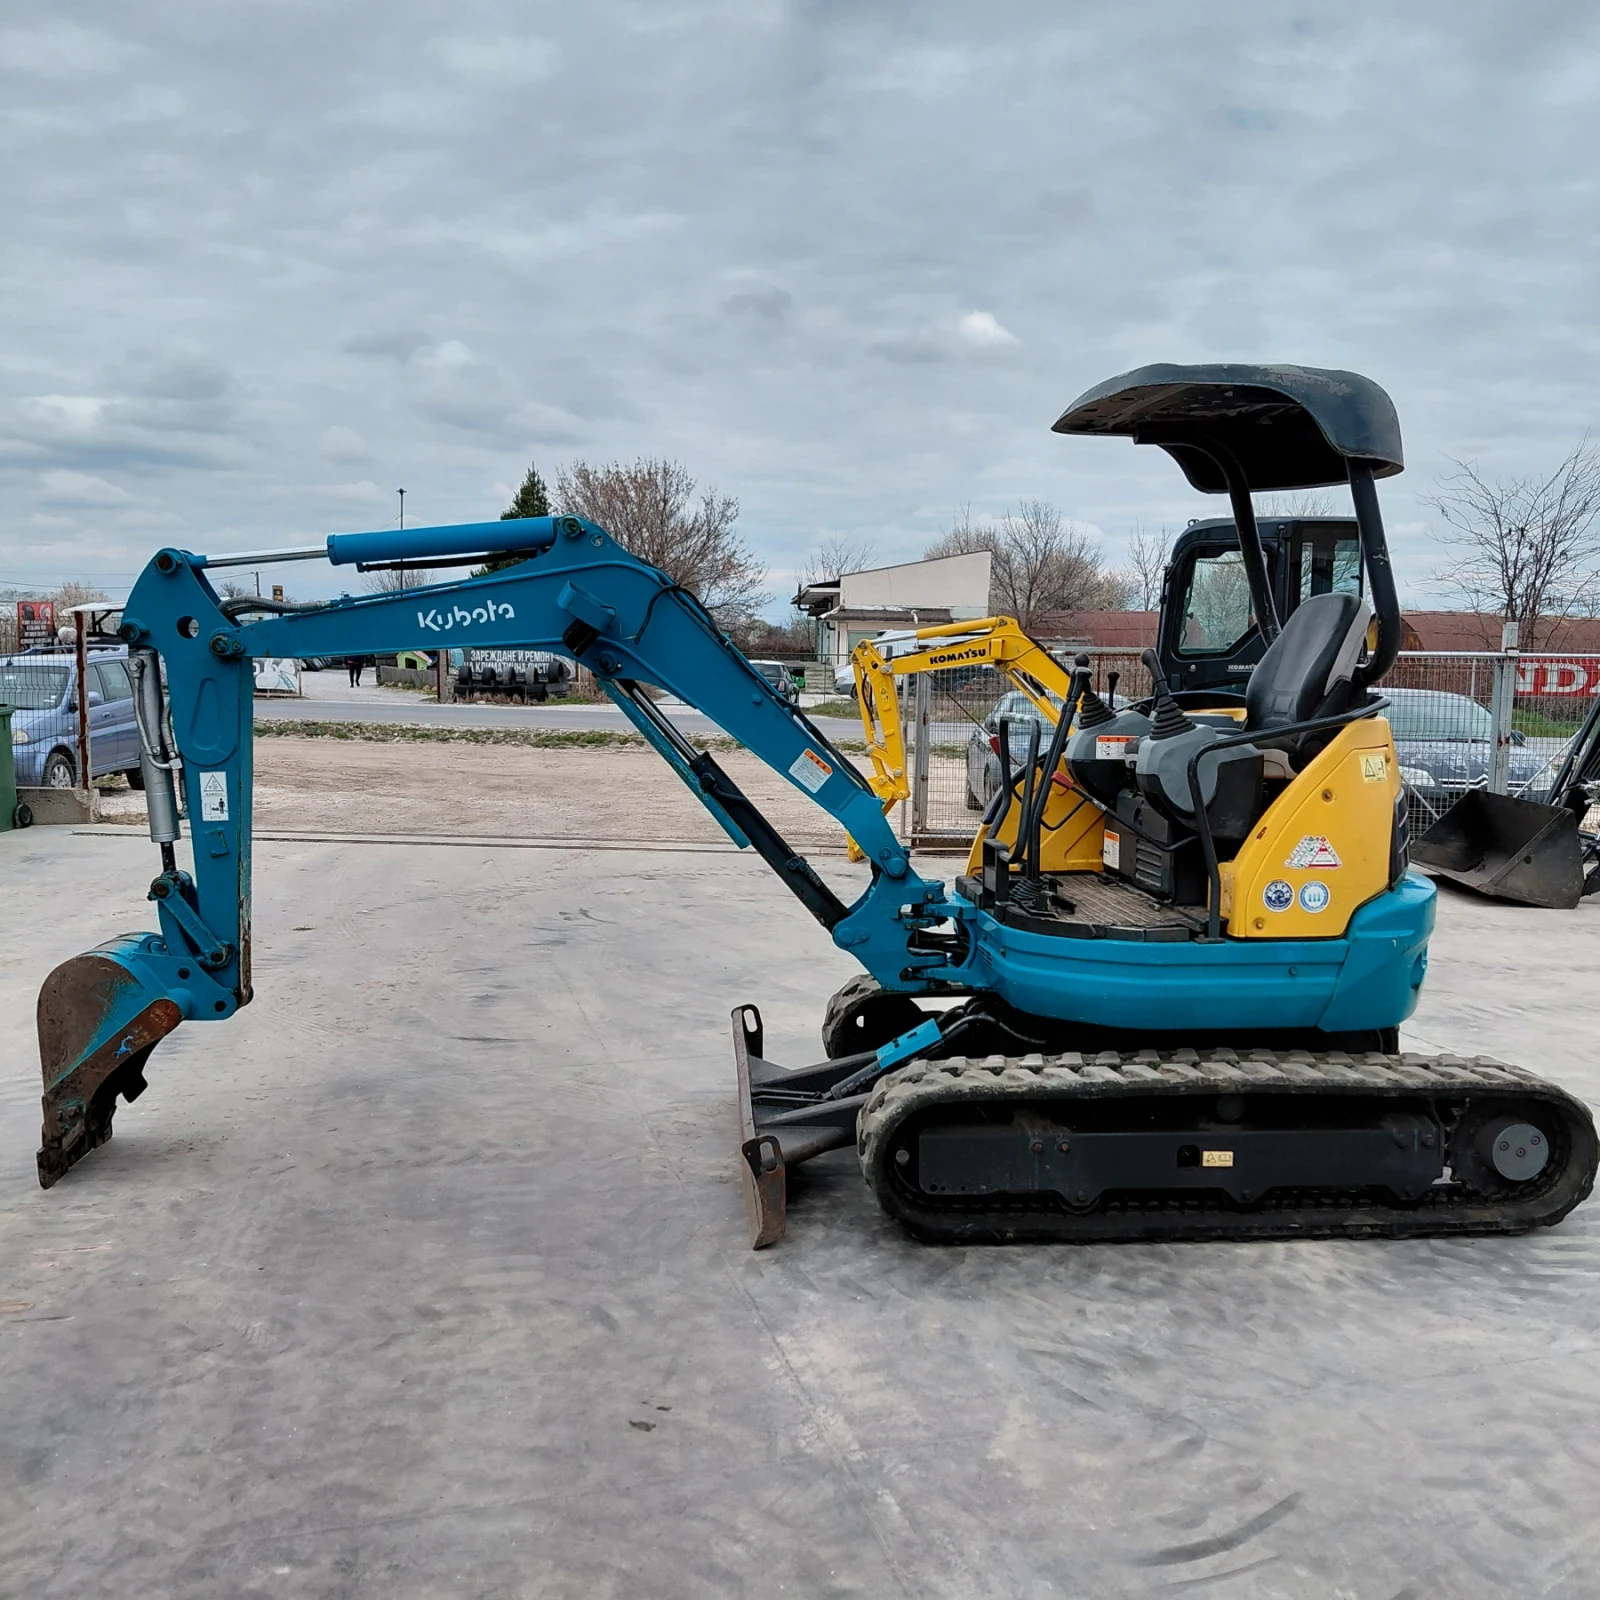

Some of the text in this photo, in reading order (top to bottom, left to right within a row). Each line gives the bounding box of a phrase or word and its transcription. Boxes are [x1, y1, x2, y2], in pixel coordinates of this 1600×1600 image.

[417, 599, 515, 632] Kubota
[470, 649, 517, 662] ЗАРЕЖДАНЕ
[517, 649, 525, 662] И
[929, 648, 986, 665] KOMATSU
